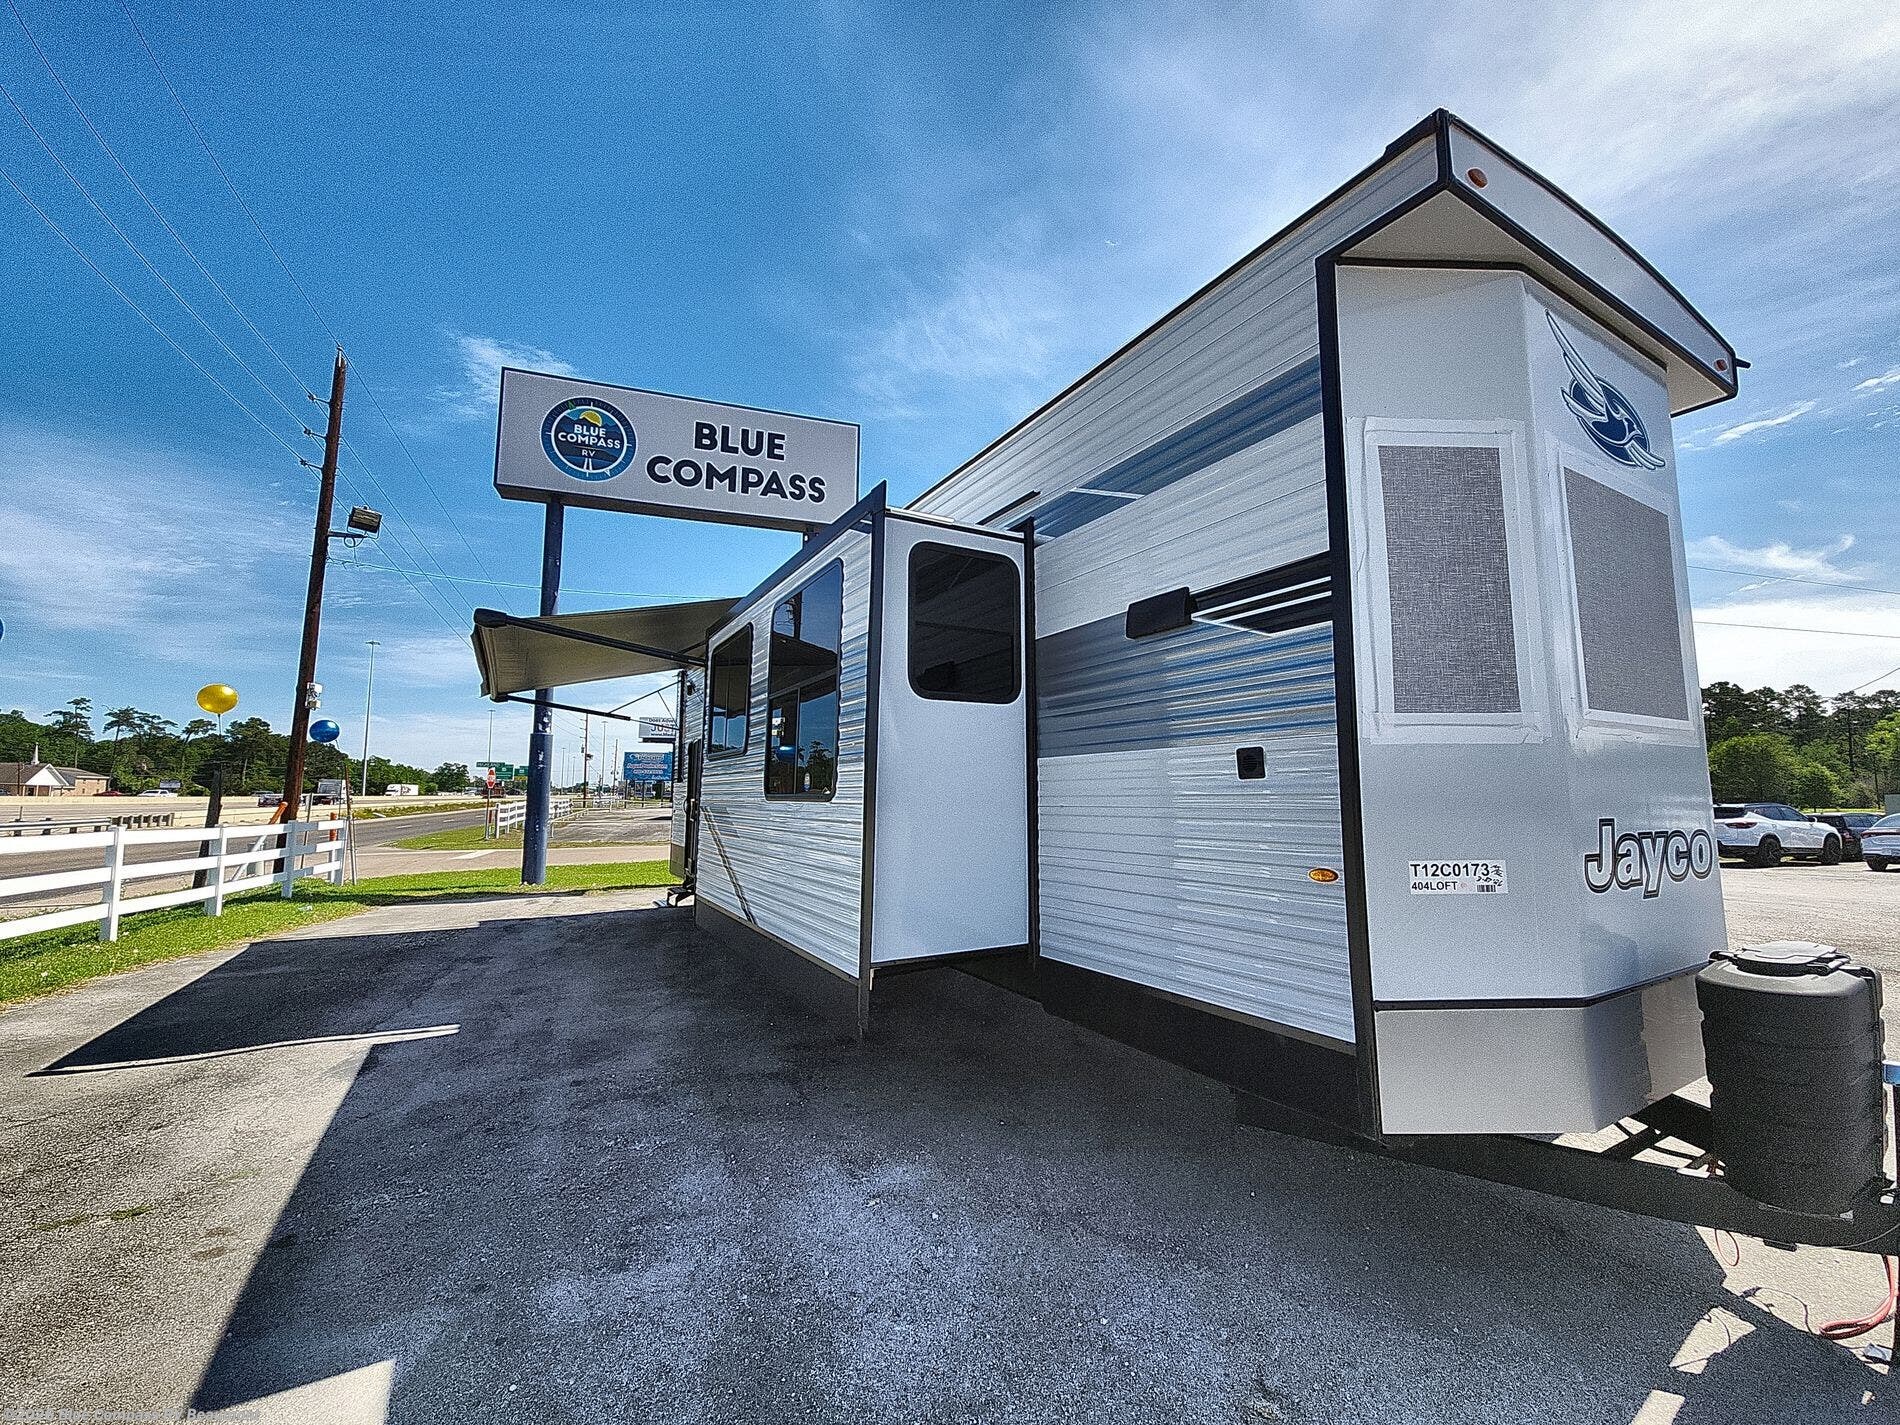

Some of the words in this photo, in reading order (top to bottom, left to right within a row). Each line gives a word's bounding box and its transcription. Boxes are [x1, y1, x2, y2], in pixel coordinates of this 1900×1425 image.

[574, 424, 606, 438] BLUE
[557, 432, 621, 449] COMPASS
[694, 421, 786, 461] BLUE
[582, 449, 595, 457] RV
[646, 455, 826, 503] COMPASS
[1584, 817, 1713, 900] Jayco
[1410, 863, 1491, 877] T12C0173
[1411, 881, 1458, 891] 404LOFT
